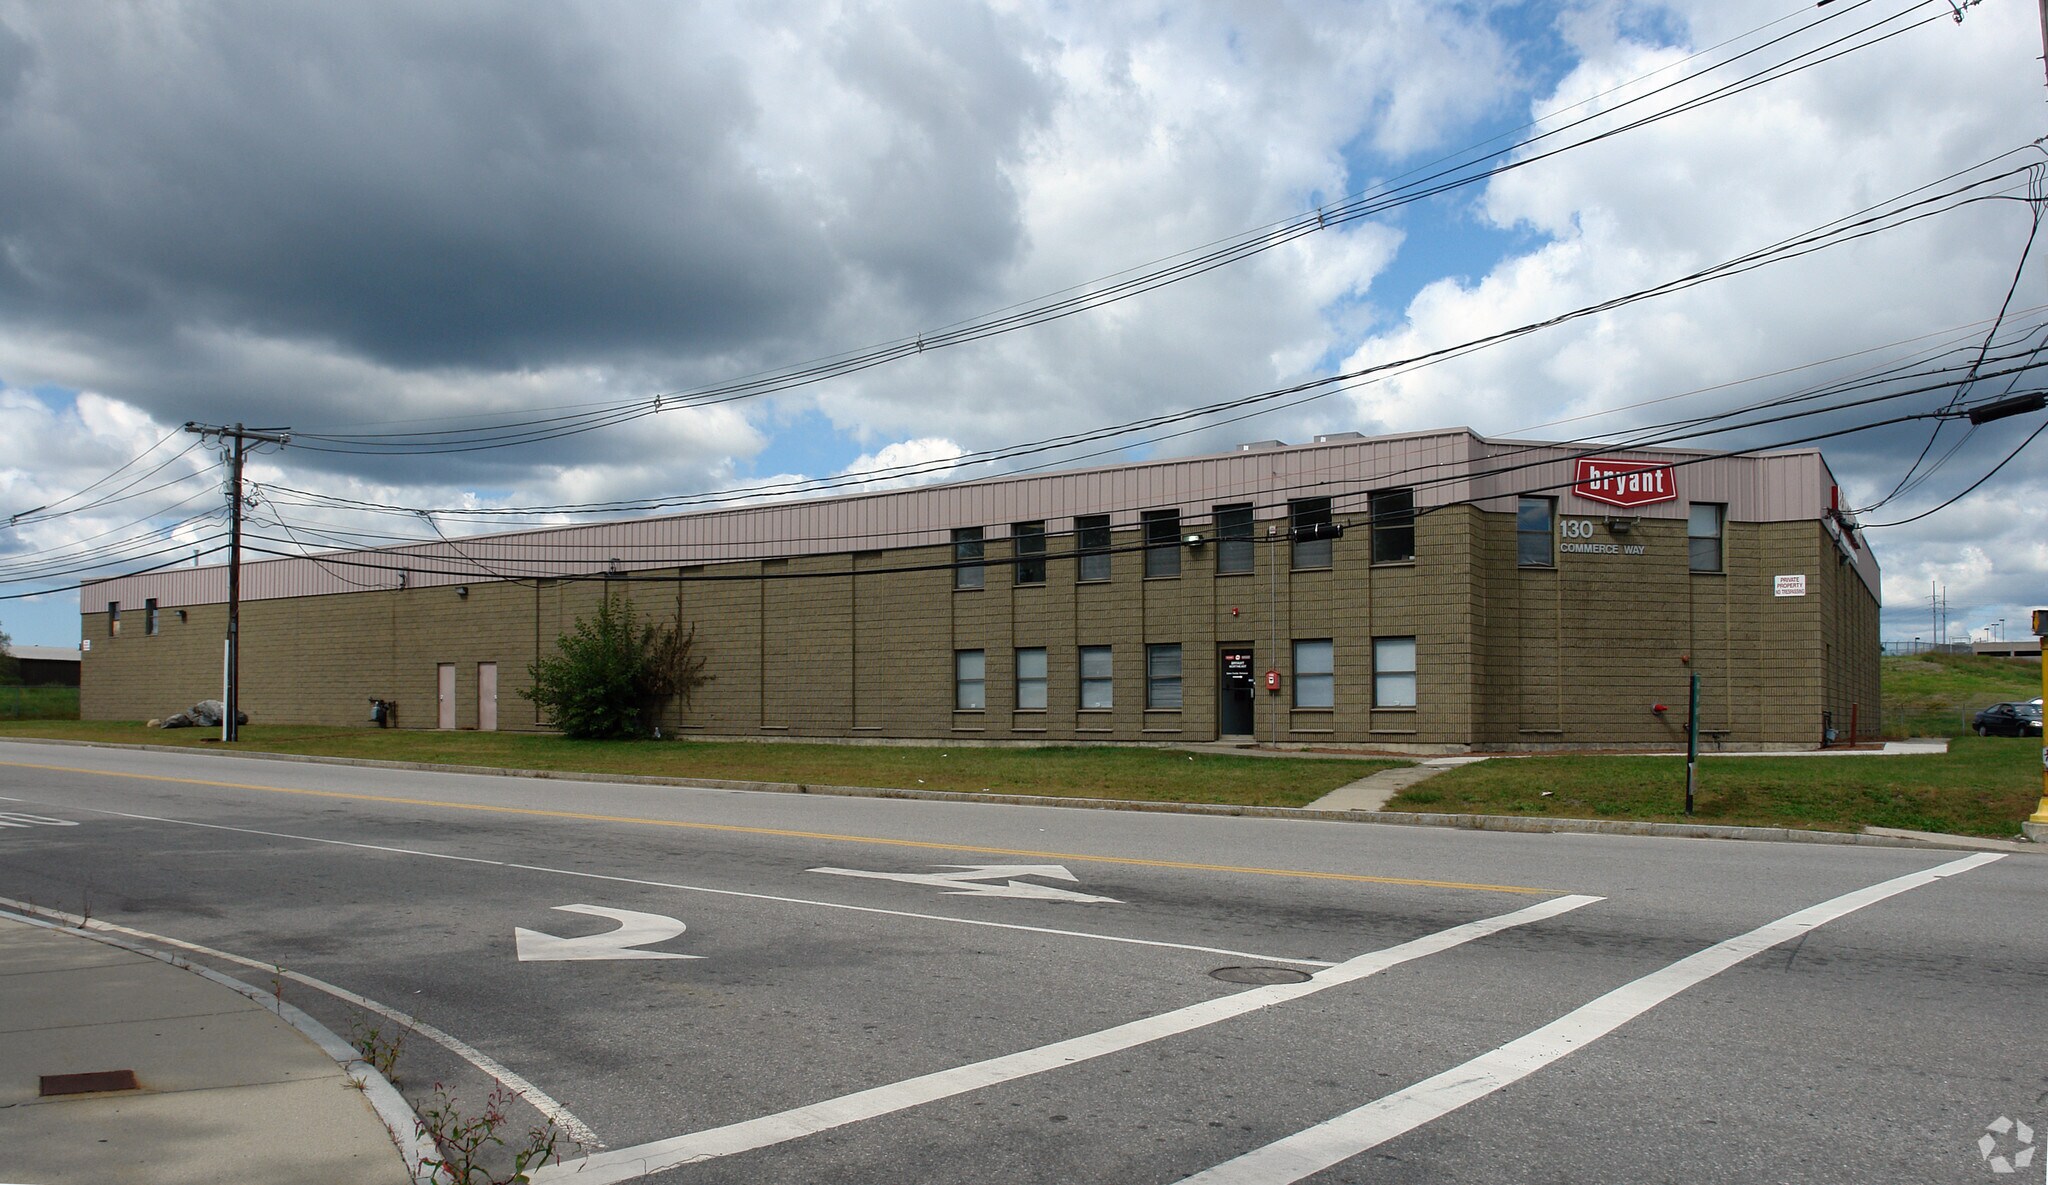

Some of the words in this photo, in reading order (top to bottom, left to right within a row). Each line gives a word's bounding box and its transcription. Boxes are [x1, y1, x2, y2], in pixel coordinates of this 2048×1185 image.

[1589, 465, 1664, 495] bryant
[1560, 520, 1594, 538] 130
[1560, 543, 1619, 554] COMMERCE
[1624, 545, 1645, 554] WAY
